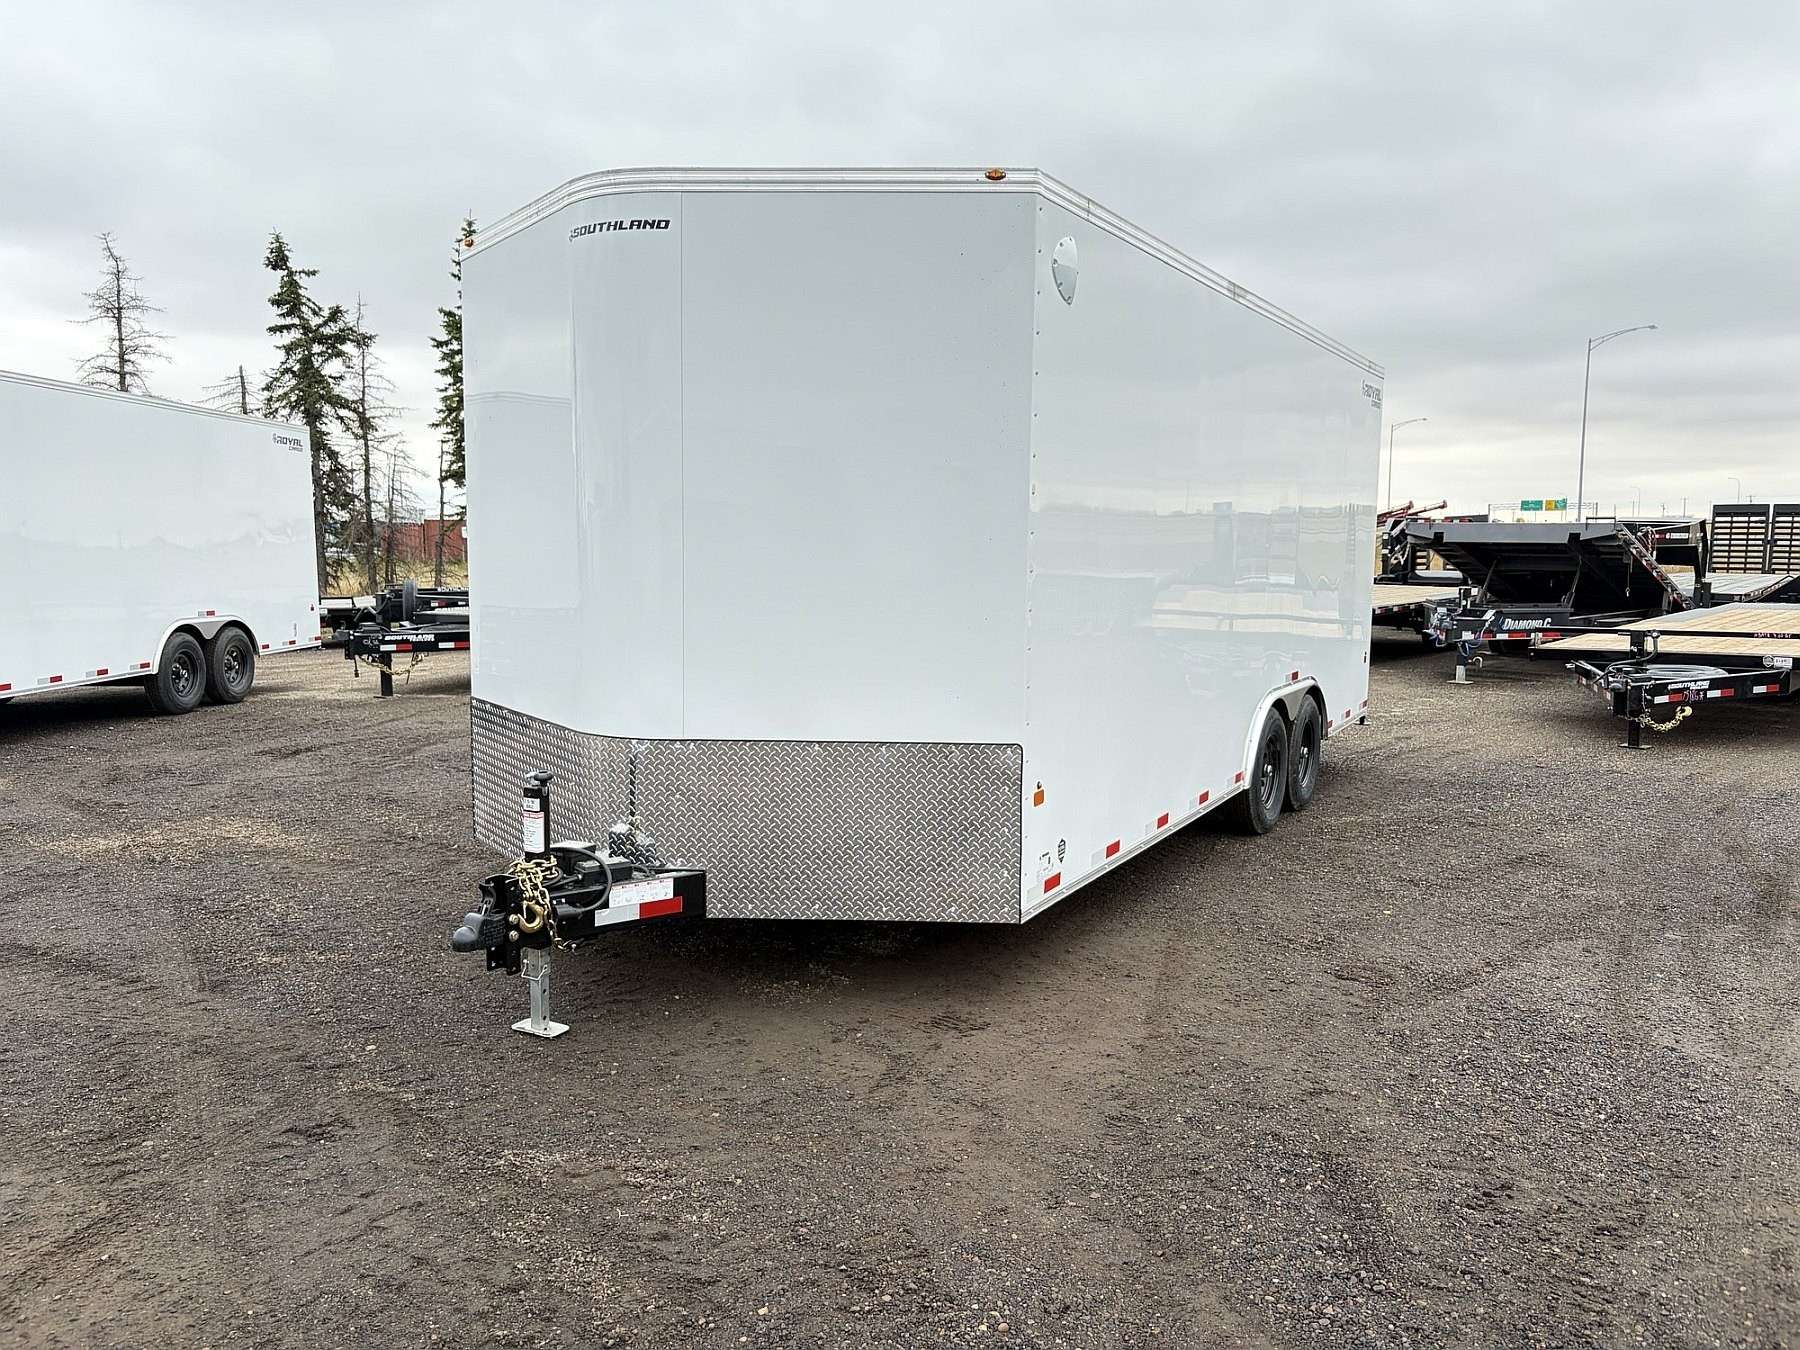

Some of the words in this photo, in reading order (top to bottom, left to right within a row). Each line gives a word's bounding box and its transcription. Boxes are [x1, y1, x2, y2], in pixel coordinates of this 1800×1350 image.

[570, 219, 671, 239] SOUTHLAND
[276, 435, 304, 448] ROYAL
[1502, 618, 1543, 630] DIAMOND
[1543, 617, 1552, 628] C
